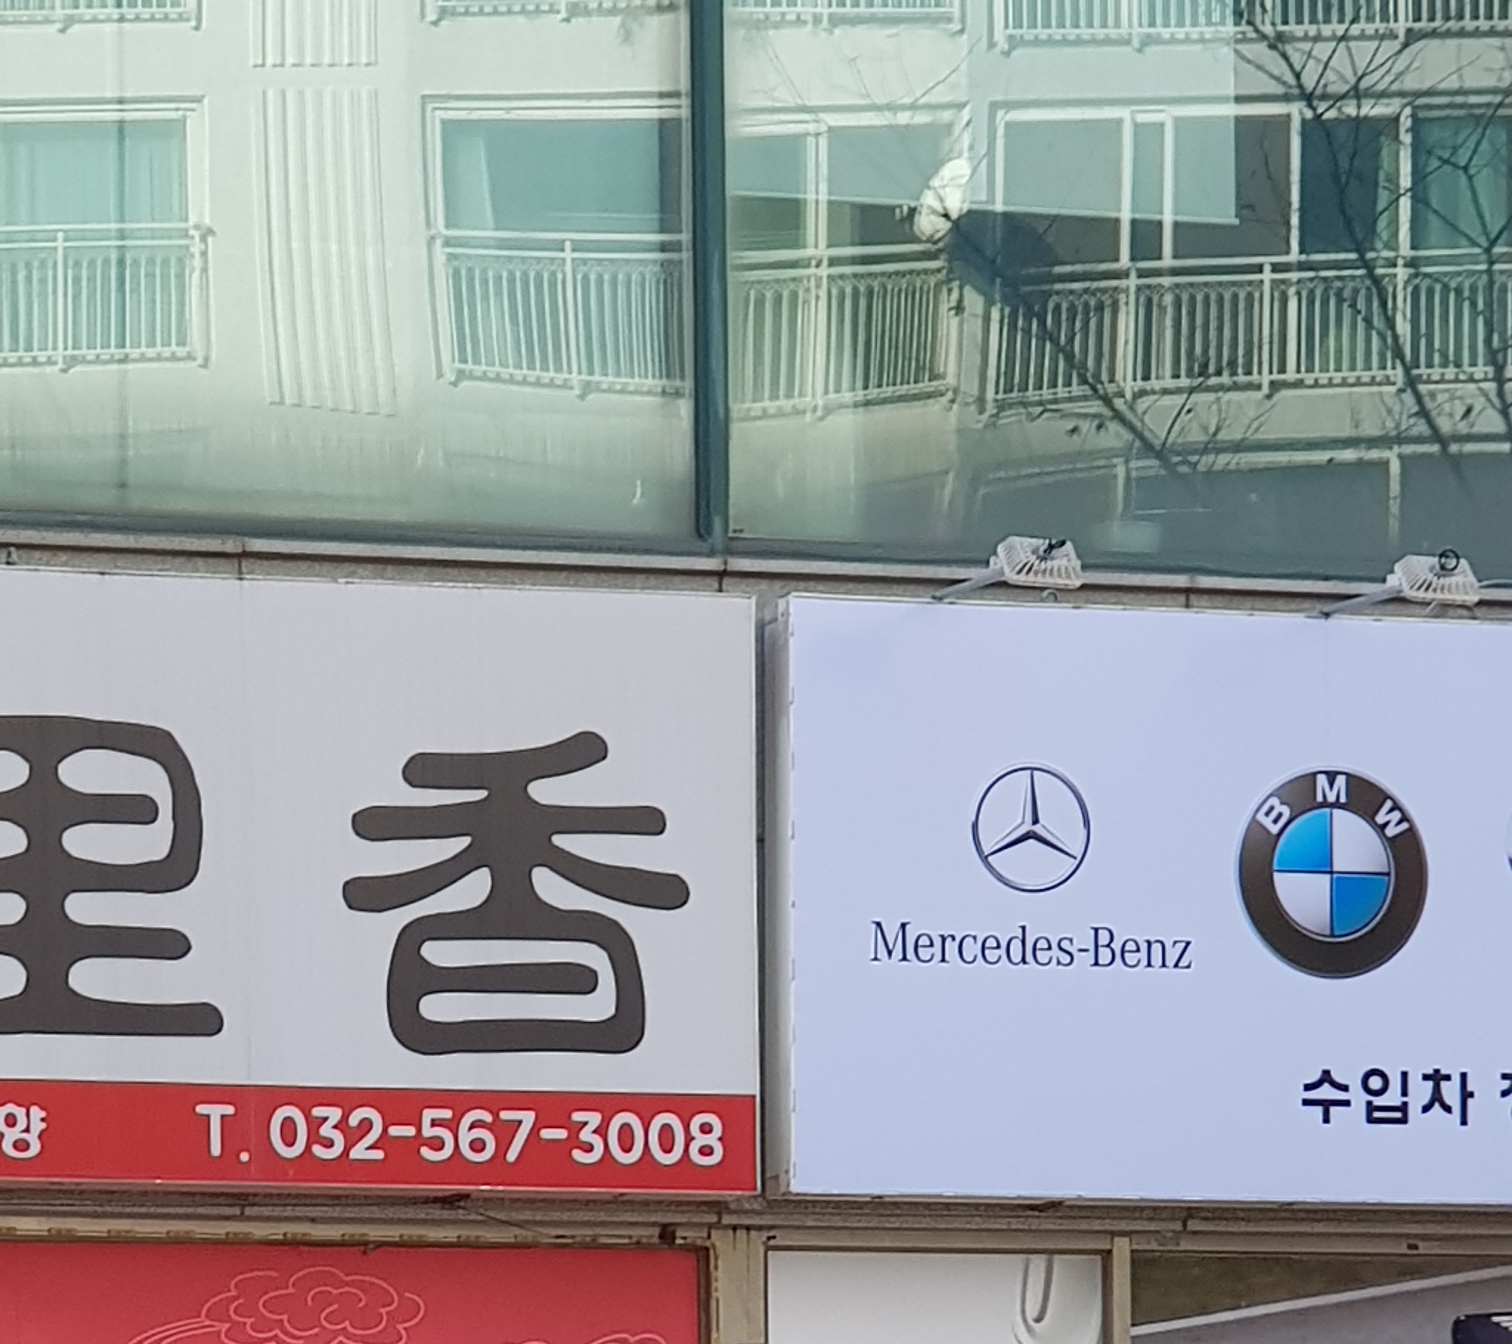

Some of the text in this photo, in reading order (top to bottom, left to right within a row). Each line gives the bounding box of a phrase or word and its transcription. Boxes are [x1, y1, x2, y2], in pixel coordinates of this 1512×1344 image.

[1254, 772, 1410, 839] BMW
[869, 919, 1194, 971] Mercedes-Benz
[1301, 1066, 1476, 1127] 수입차
[195, 1103, 250, 1163] T.
[268, 1105, 725, 1167] 032-567-3008
